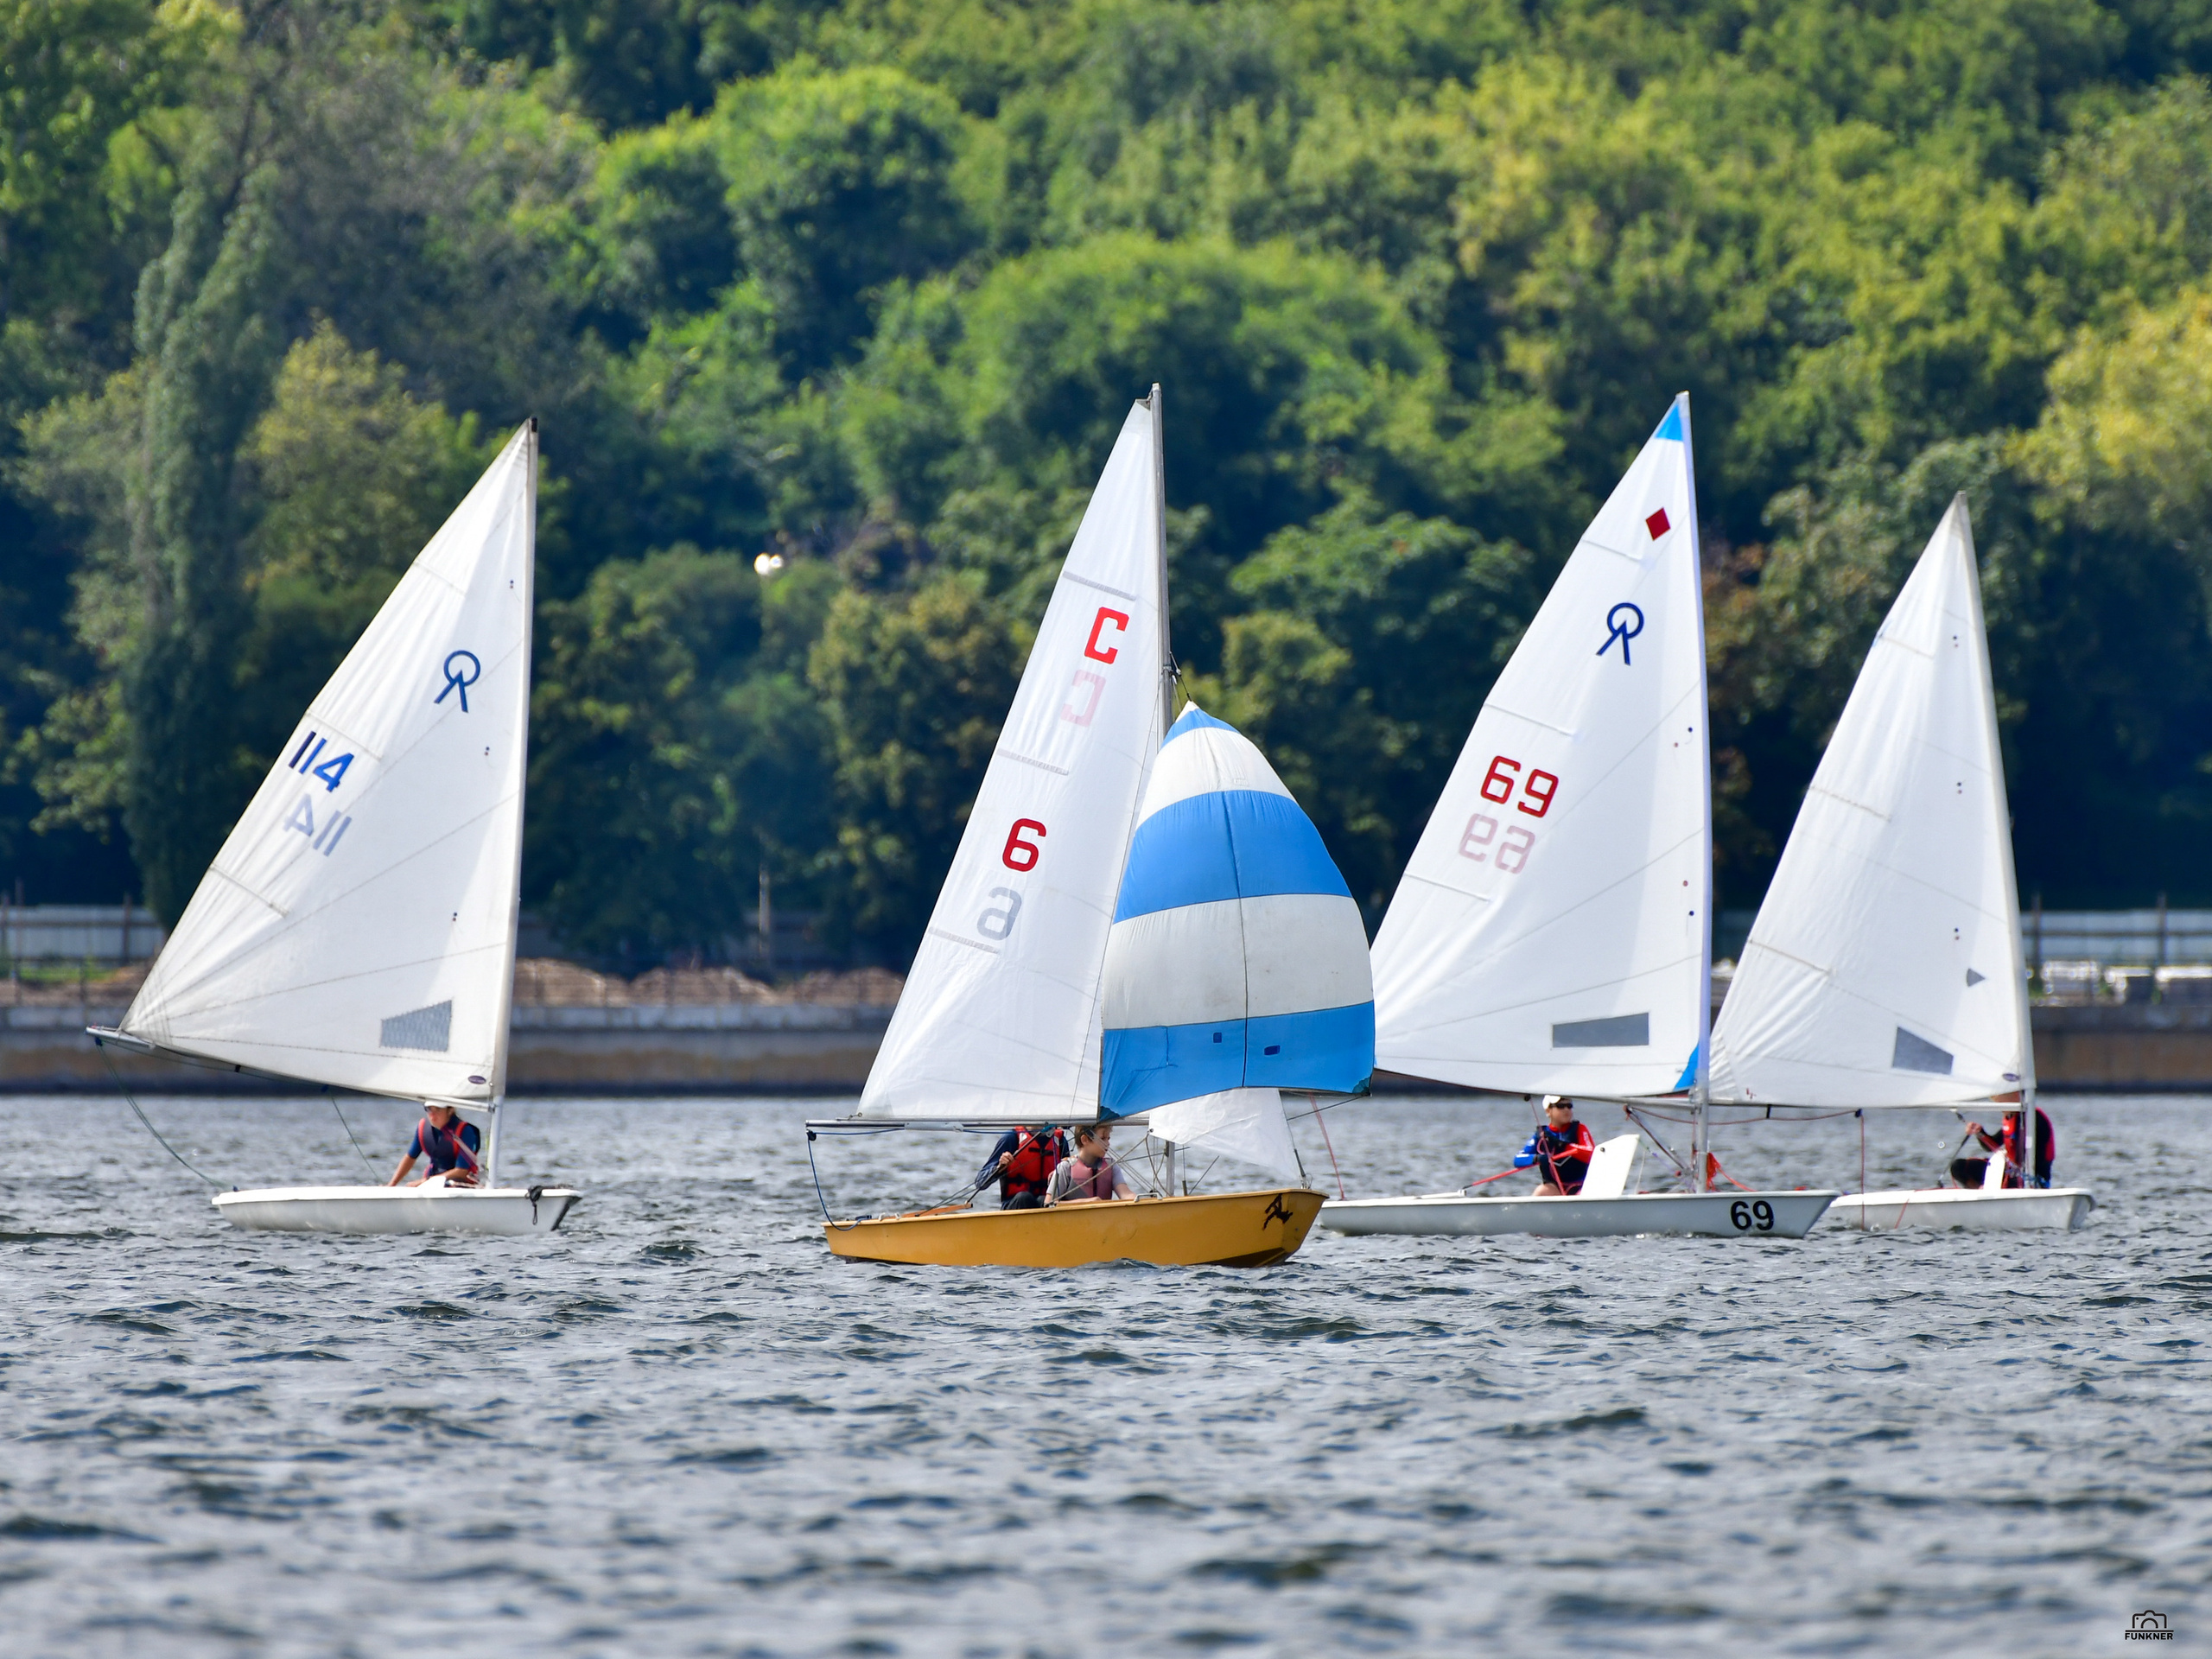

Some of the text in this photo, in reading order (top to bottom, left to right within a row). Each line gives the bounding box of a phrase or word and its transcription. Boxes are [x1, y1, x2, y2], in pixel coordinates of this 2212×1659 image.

[1084, 607, 1129, 664] C
[289, 731, 354, 792] 114
[1480, 755, 1559, 818] 69
[1002, 818, 1046, 872] 6
[1730, 1200, 1775, 1231] 69
